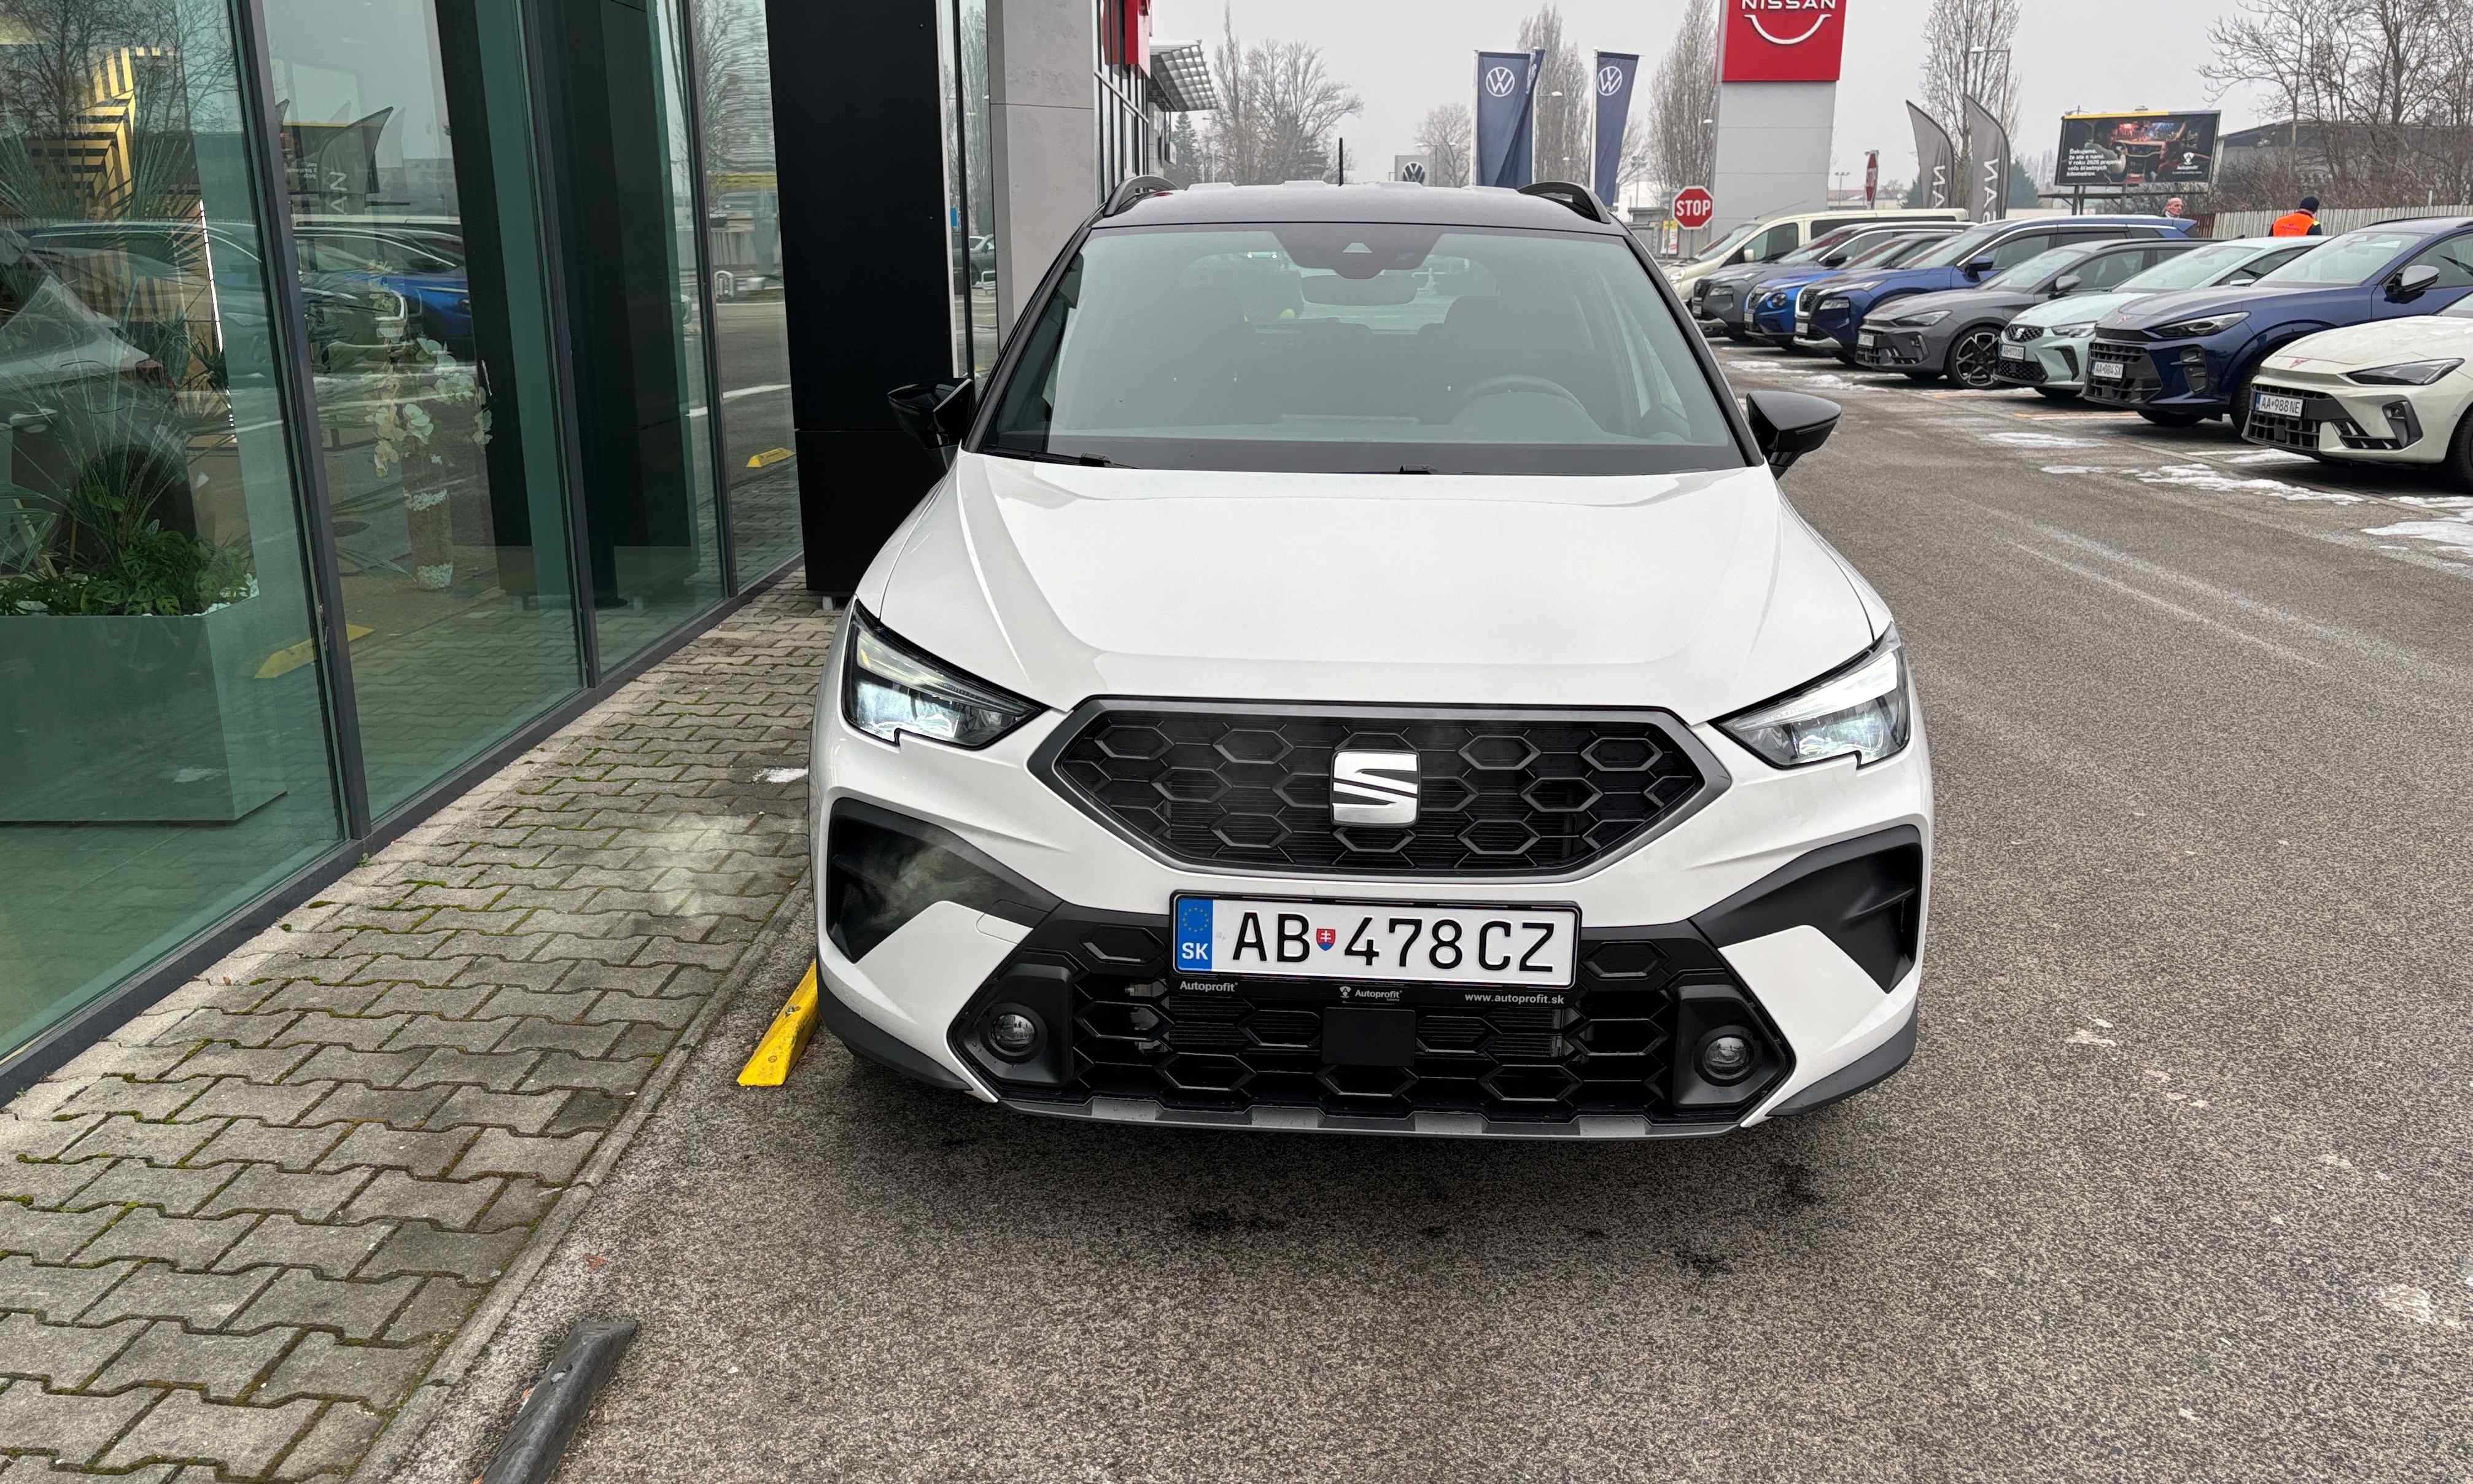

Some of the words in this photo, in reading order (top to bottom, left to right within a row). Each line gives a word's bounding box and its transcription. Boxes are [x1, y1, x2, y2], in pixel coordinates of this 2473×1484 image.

[1742, 0, 1836, 9] NISSAN
[1675, 200, 1711, 216] STOP
[2275, 399, 2300, 414] 988NE
[1232, 911, 1311, 963] AB
[1182, 942, 1208, 960] SK
[1464, 992, 1564, 1006] www.autoprofit.sk
